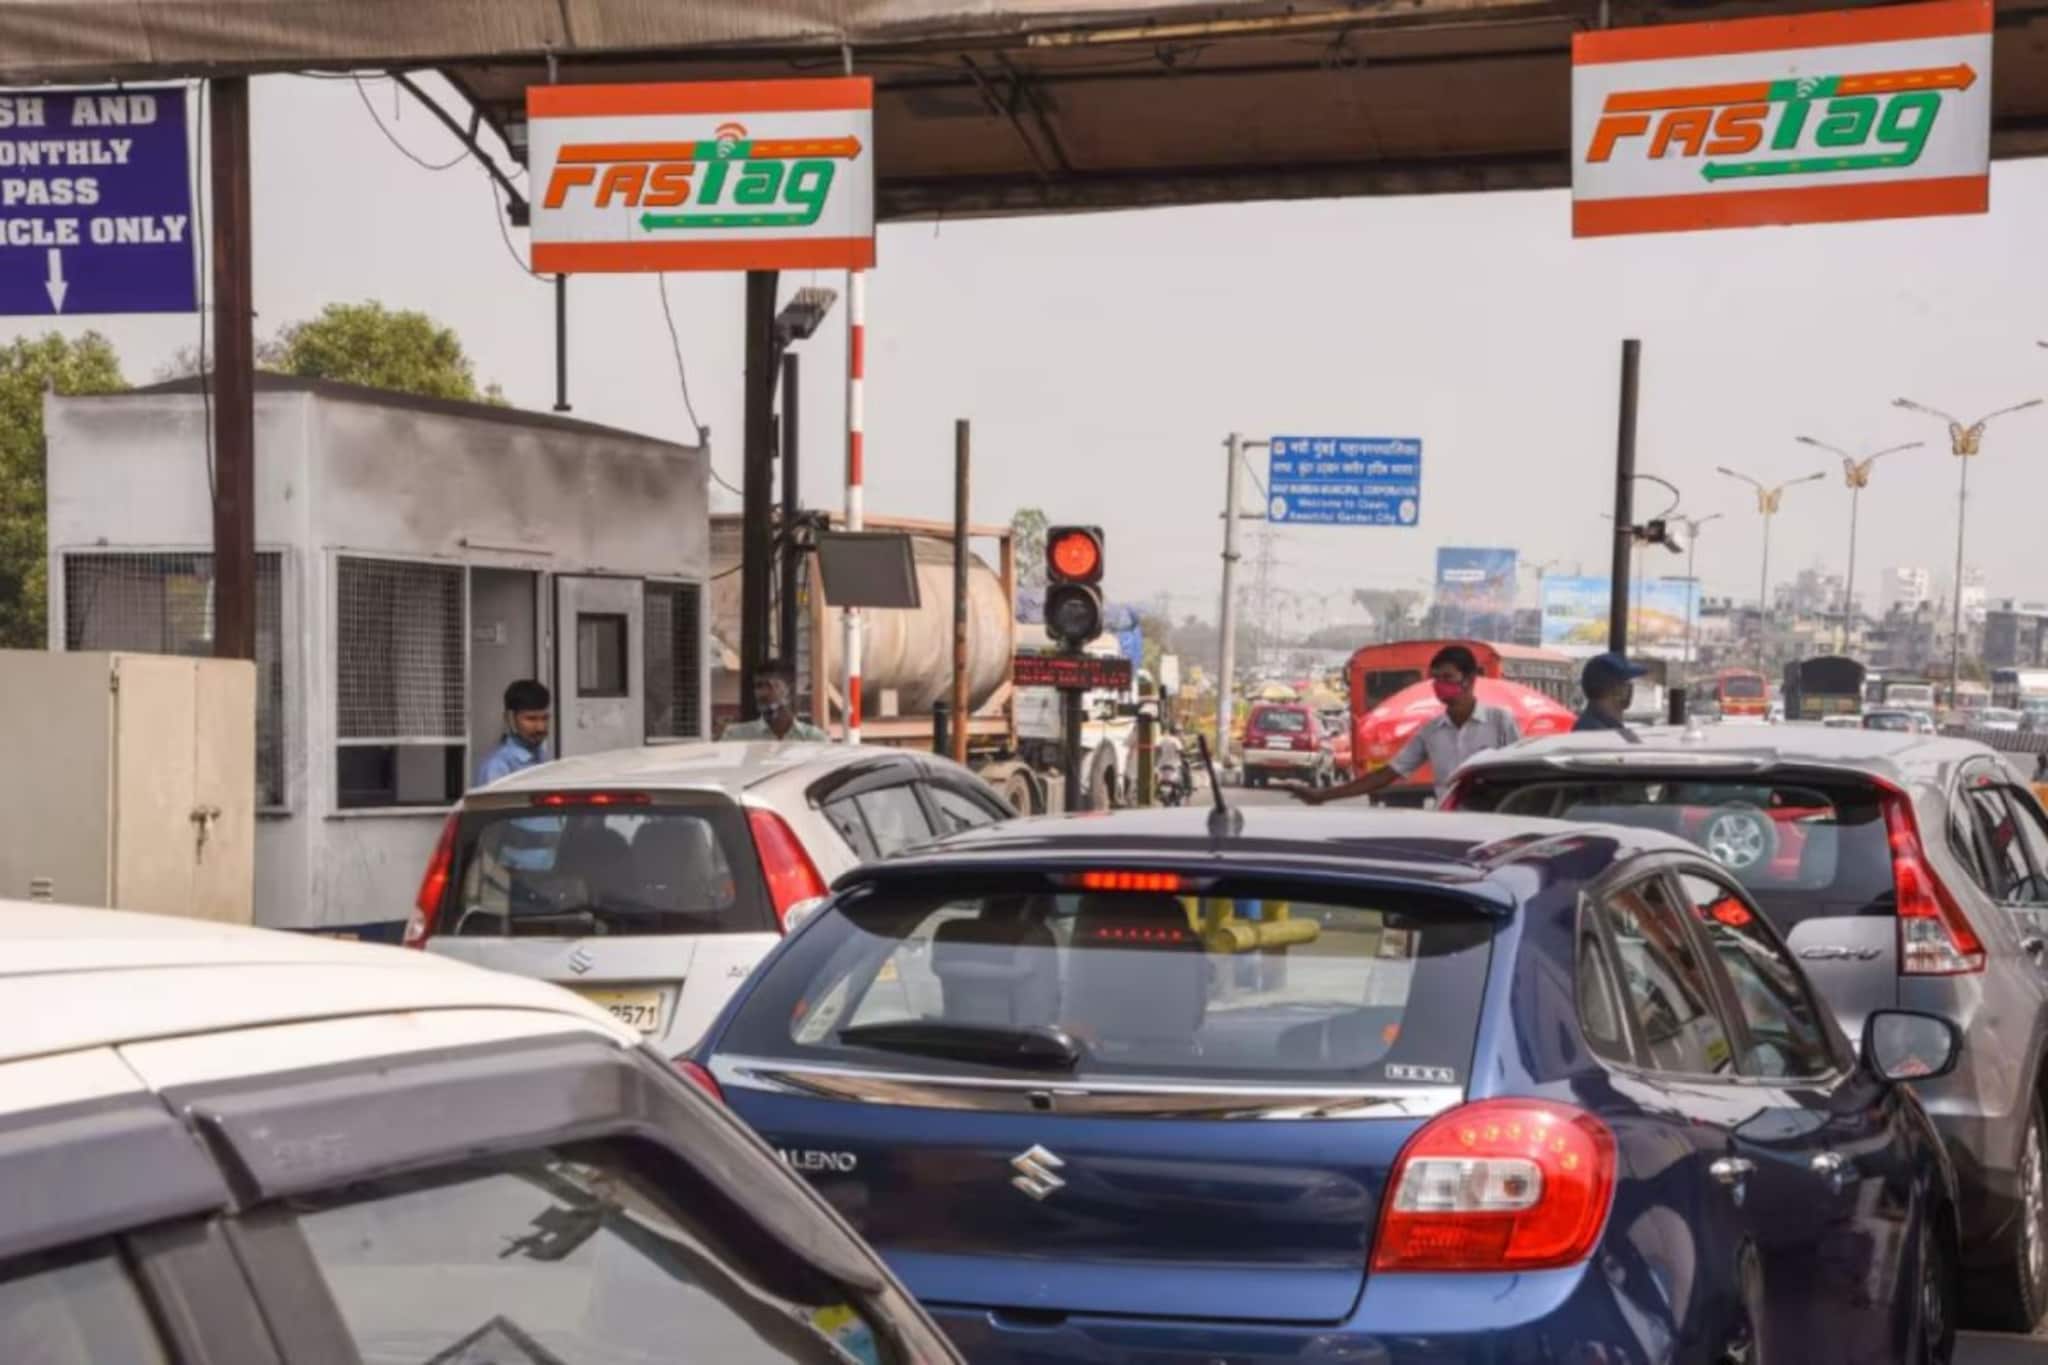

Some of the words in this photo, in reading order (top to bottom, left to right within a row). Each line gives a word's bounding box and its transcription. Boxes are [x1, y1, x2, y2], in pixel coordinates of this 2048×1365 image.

[72, 95, 157, 126] AND
[2, 178, 100, 205] PASS
[90, 215, 187, 244] ONLY
